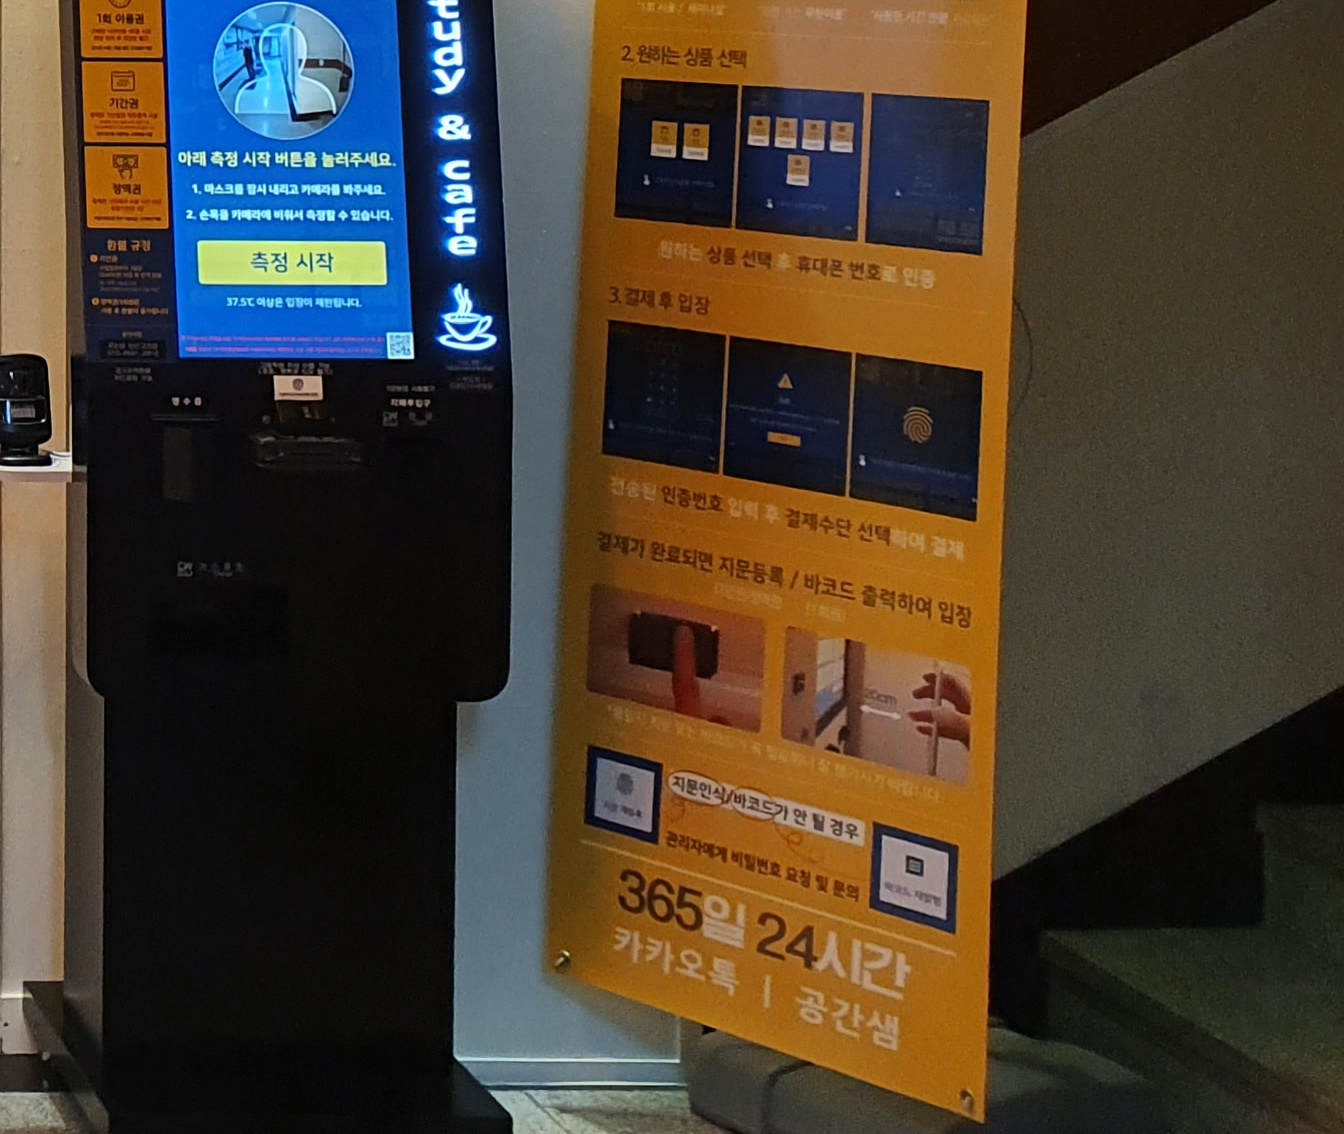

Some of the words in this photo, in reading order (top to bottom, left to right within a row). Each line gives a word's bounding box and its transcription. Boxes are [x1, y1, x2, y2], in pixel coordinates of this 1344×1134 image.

[637, 45, 681, 65] 원하는
[683, 47, 713, 67] 상품
[717, 49, 748, 68] 선택
[437, 115, 471, 140] &
[178, 151, 207, 167] 아래
[210, 152, 238, 167] 측정
[242, 152, 271, 167] 시작
[274, 152, 317, 168] 버튼을
[321, 152, 396, 168] 눌러주세요.
[204, 184, 243, 196] 마스크를
[246, 184, 267, 195] 잠시
[268, 184, 299, 195] 내리고
[301, 184, 340, 195] 카메라를
[199, 209, 229, 221] 손목을
[306, 209, 336, 221] 측정할
[338, 210, 348, 221] 수
[350, 210, 394, 222] 있습니다.
[250, 252, 289, 273] 측정
[296, 252, 334, 273] 시작
[659, 239, 703, 262] 원하는
[706, 245, 736, 266] 상품
[741, 248, 772, 270] 선택
[796, 256, 842, 279] 휴대폰
[849, 259, 898, 285] 번호로
[902, 265, 936, 290] 인증
[625, 287, 656, 309] 결제
[658, 290, 674, 310] 후
[678, 293, 710, 316] 입장
[661, 486, 724, 513] 인증번호
[785, 507, 852, 540] 결제수단
[597, 531, 645, 559] 결제가
[650, 540, 714, 572] 완료되면
[718, 555, 784, 586] 지문등록
[803, 573, 856, 601] 바코드
[862, 584, 932, 619] 출력하여
[937, 600, 973, 629] 입장
[794, 807, 808, 827] 안
[829, 818, 860, 841] 경우
[666, 830, 728, 864] 관리자에게
[731, 851, 781, 879] 비밀번호
[786, 867, 812, 889] 요청
[816, 875, 829, 893] 및
[833, 879, 860, 903] 문의
[617, 869, 746, 949] 365일
[757, 911, 911, 1000] 24시간
[614, 926, 740, 996] 카카오톡
[795, 985, 900, 1050] 공간샘
